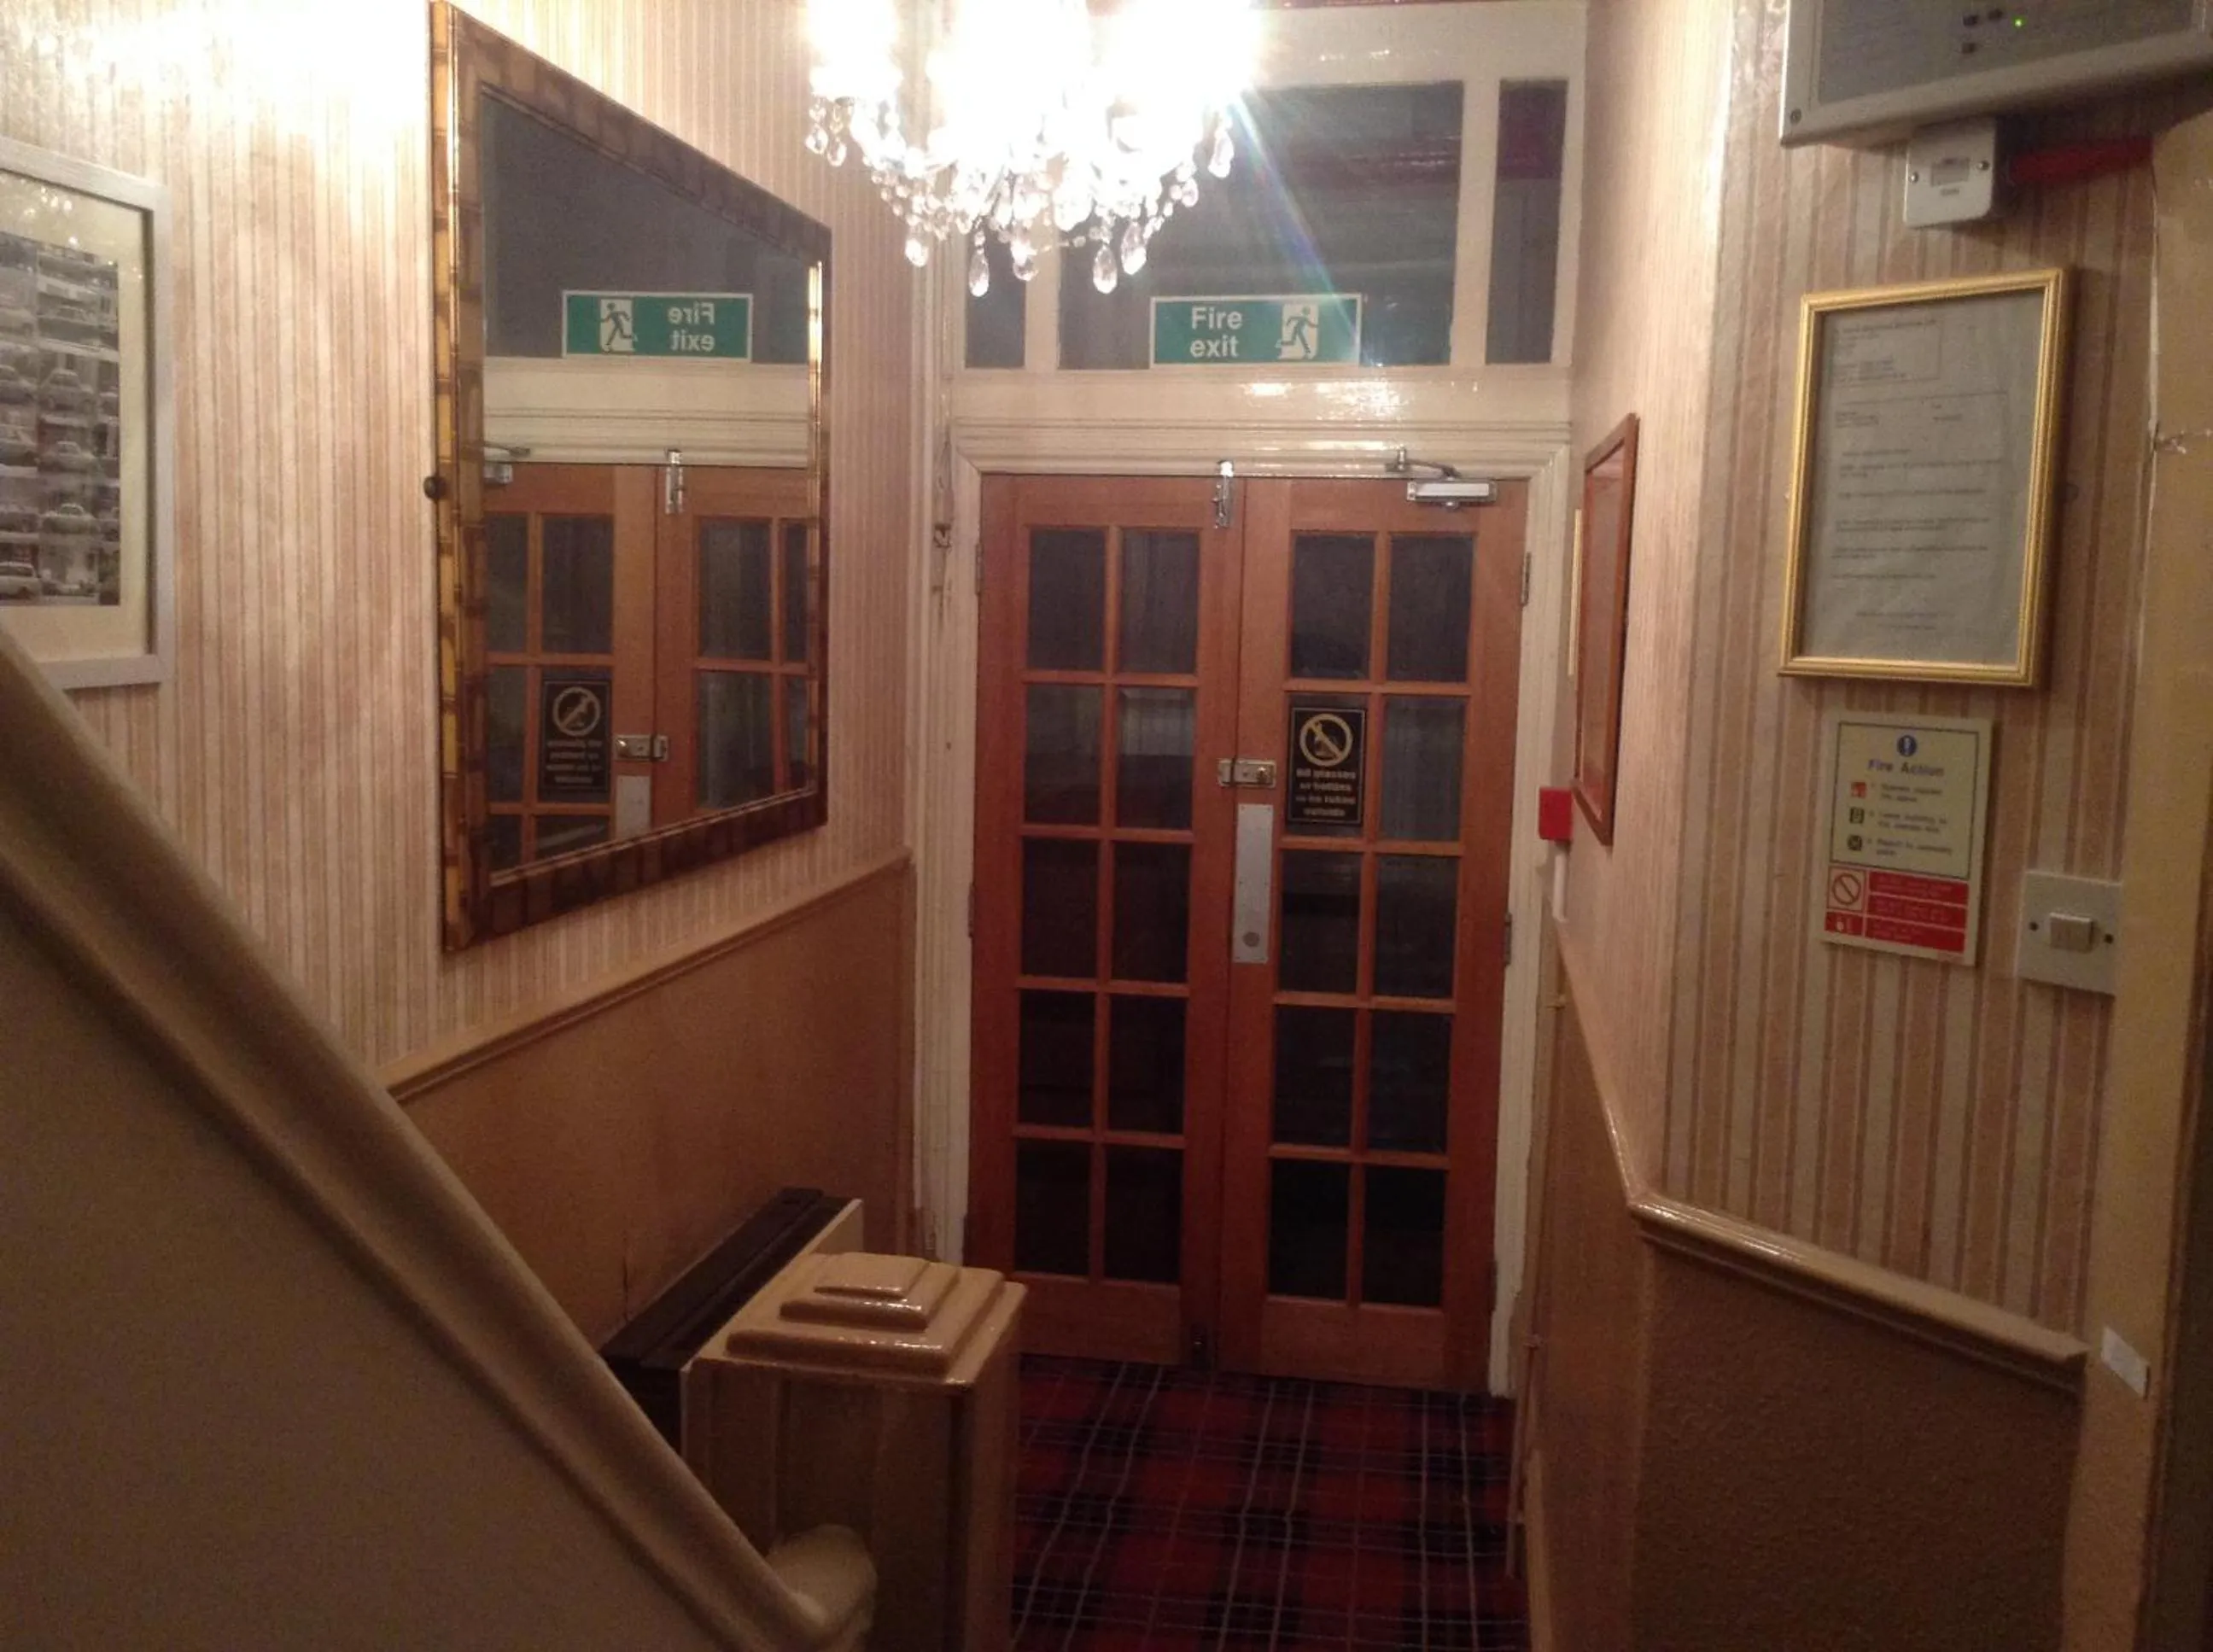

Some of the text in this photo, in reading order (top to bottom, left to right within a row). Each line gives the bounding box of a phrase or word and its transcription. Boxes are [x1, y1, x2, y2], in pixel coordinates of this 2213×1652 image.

[1190, 306, 1243, 330] Fire
[1189, 335, 1239, 358] exit
[1868, 759, 1944, 776] Fire Action
